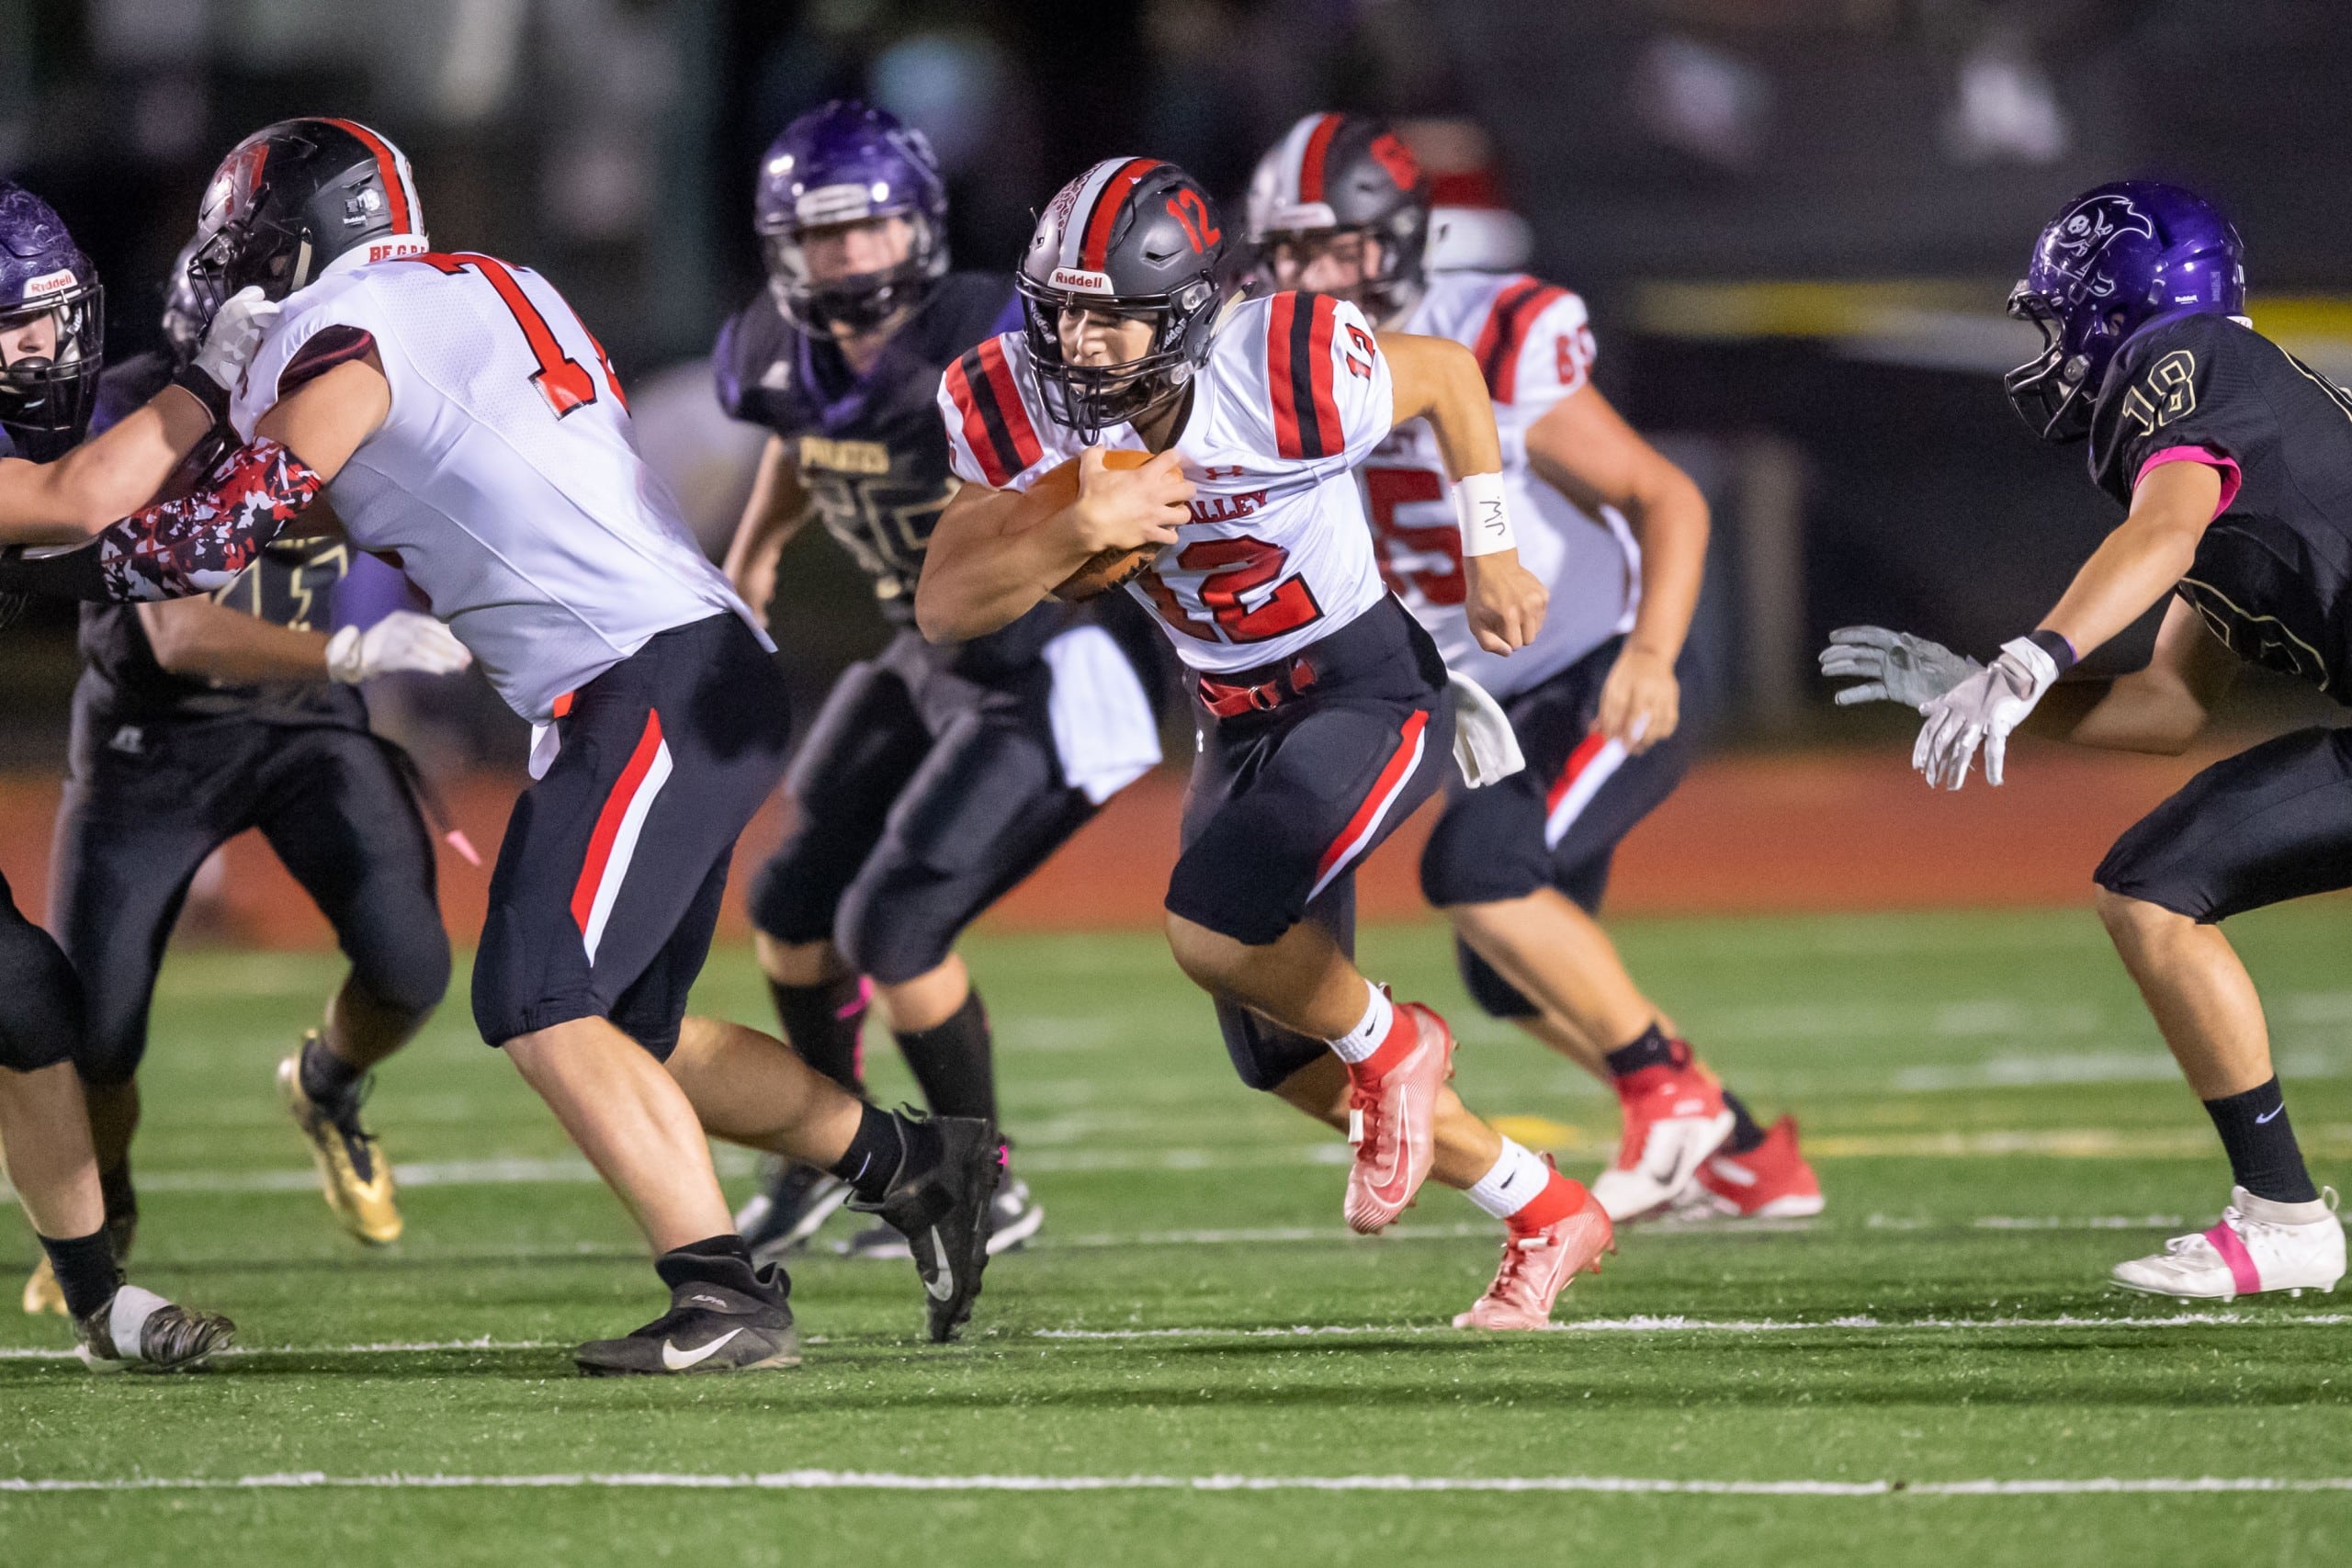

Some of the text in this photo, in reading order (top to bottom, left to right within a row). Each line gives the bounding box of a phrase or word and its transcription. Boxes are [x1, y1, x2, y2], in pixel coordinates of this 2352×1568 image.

[1165, 187, 1221, 254] 12
[30, 275, 73, 293] Riddell
[1055, 271, 1103, 289] Riddell
[1179, 490, 1269, 525] ALLEY
